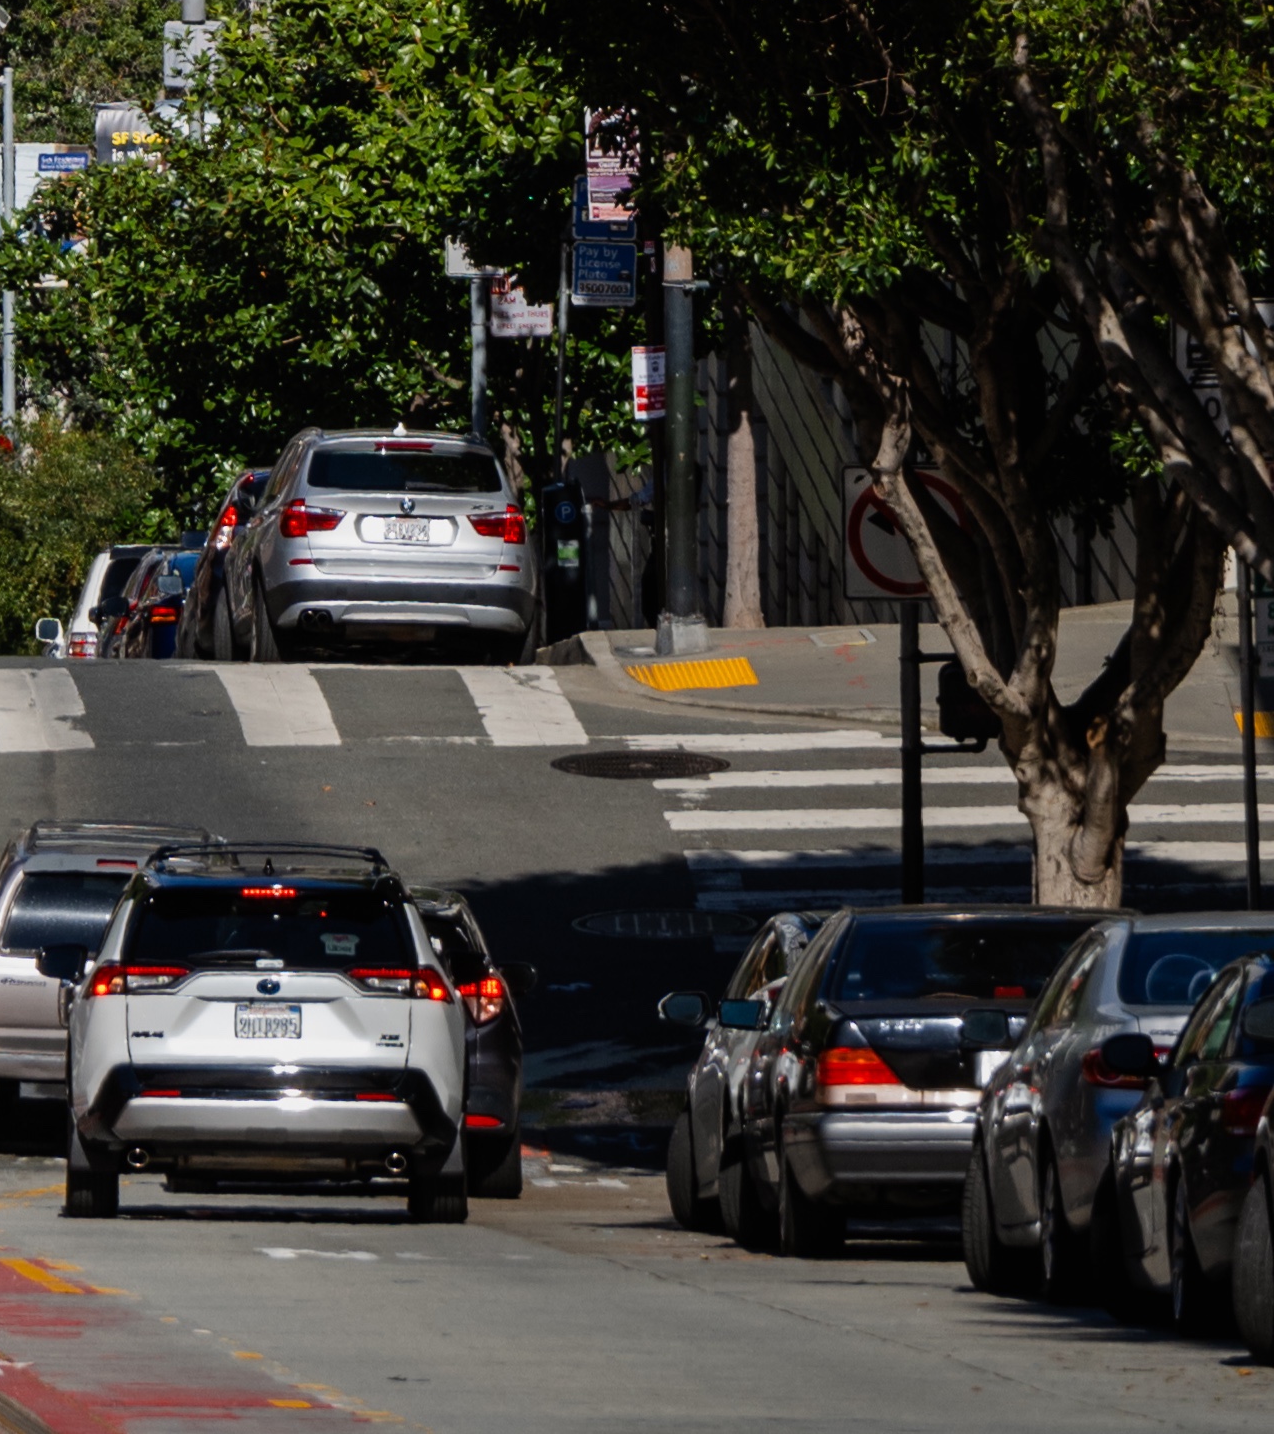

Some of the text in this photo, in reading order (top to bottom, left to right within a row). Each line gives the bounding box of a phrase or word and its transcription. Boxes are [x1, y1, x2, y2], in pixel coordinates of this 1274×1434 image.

[112, 131, 129, 145] SF
[579, 246, 618, 260] Pay by
[579, 257, 621, 268] License
[578, 269, 607, 279] Plate
